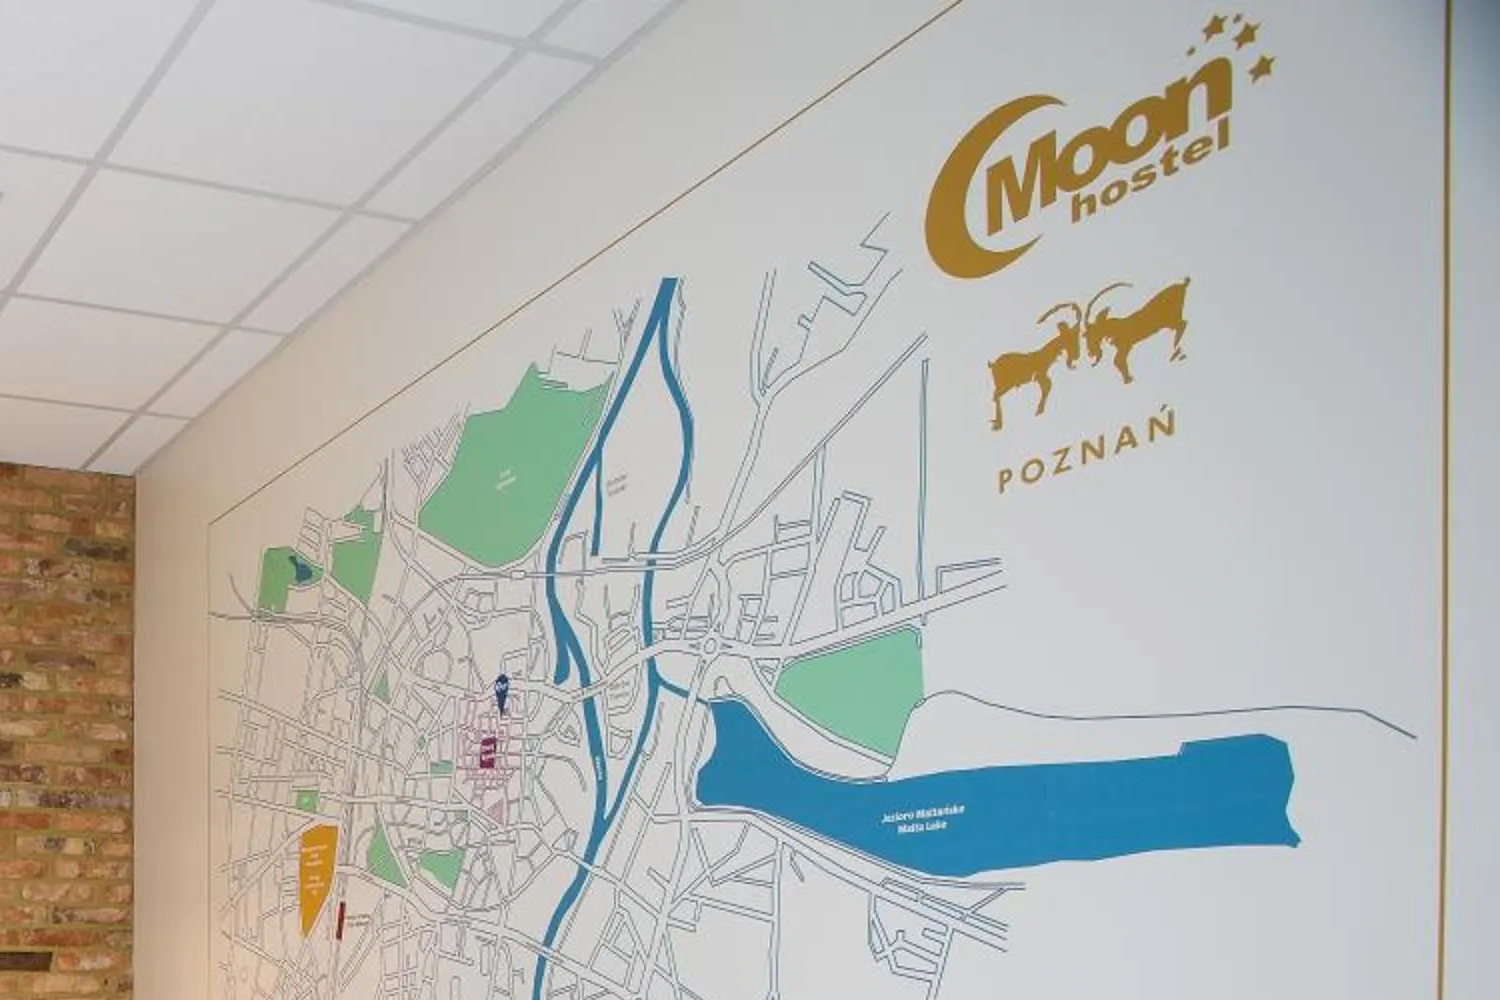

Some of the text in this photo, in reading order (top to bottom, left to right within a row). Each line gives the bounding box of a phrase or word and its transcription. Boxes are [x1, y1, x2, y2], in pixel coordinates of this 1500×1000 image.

[986, 56, 1233, 237] Moon
[1071, 117, 1230, 224] hostel
[997, 404, 1177, 494] POZNAŃ
